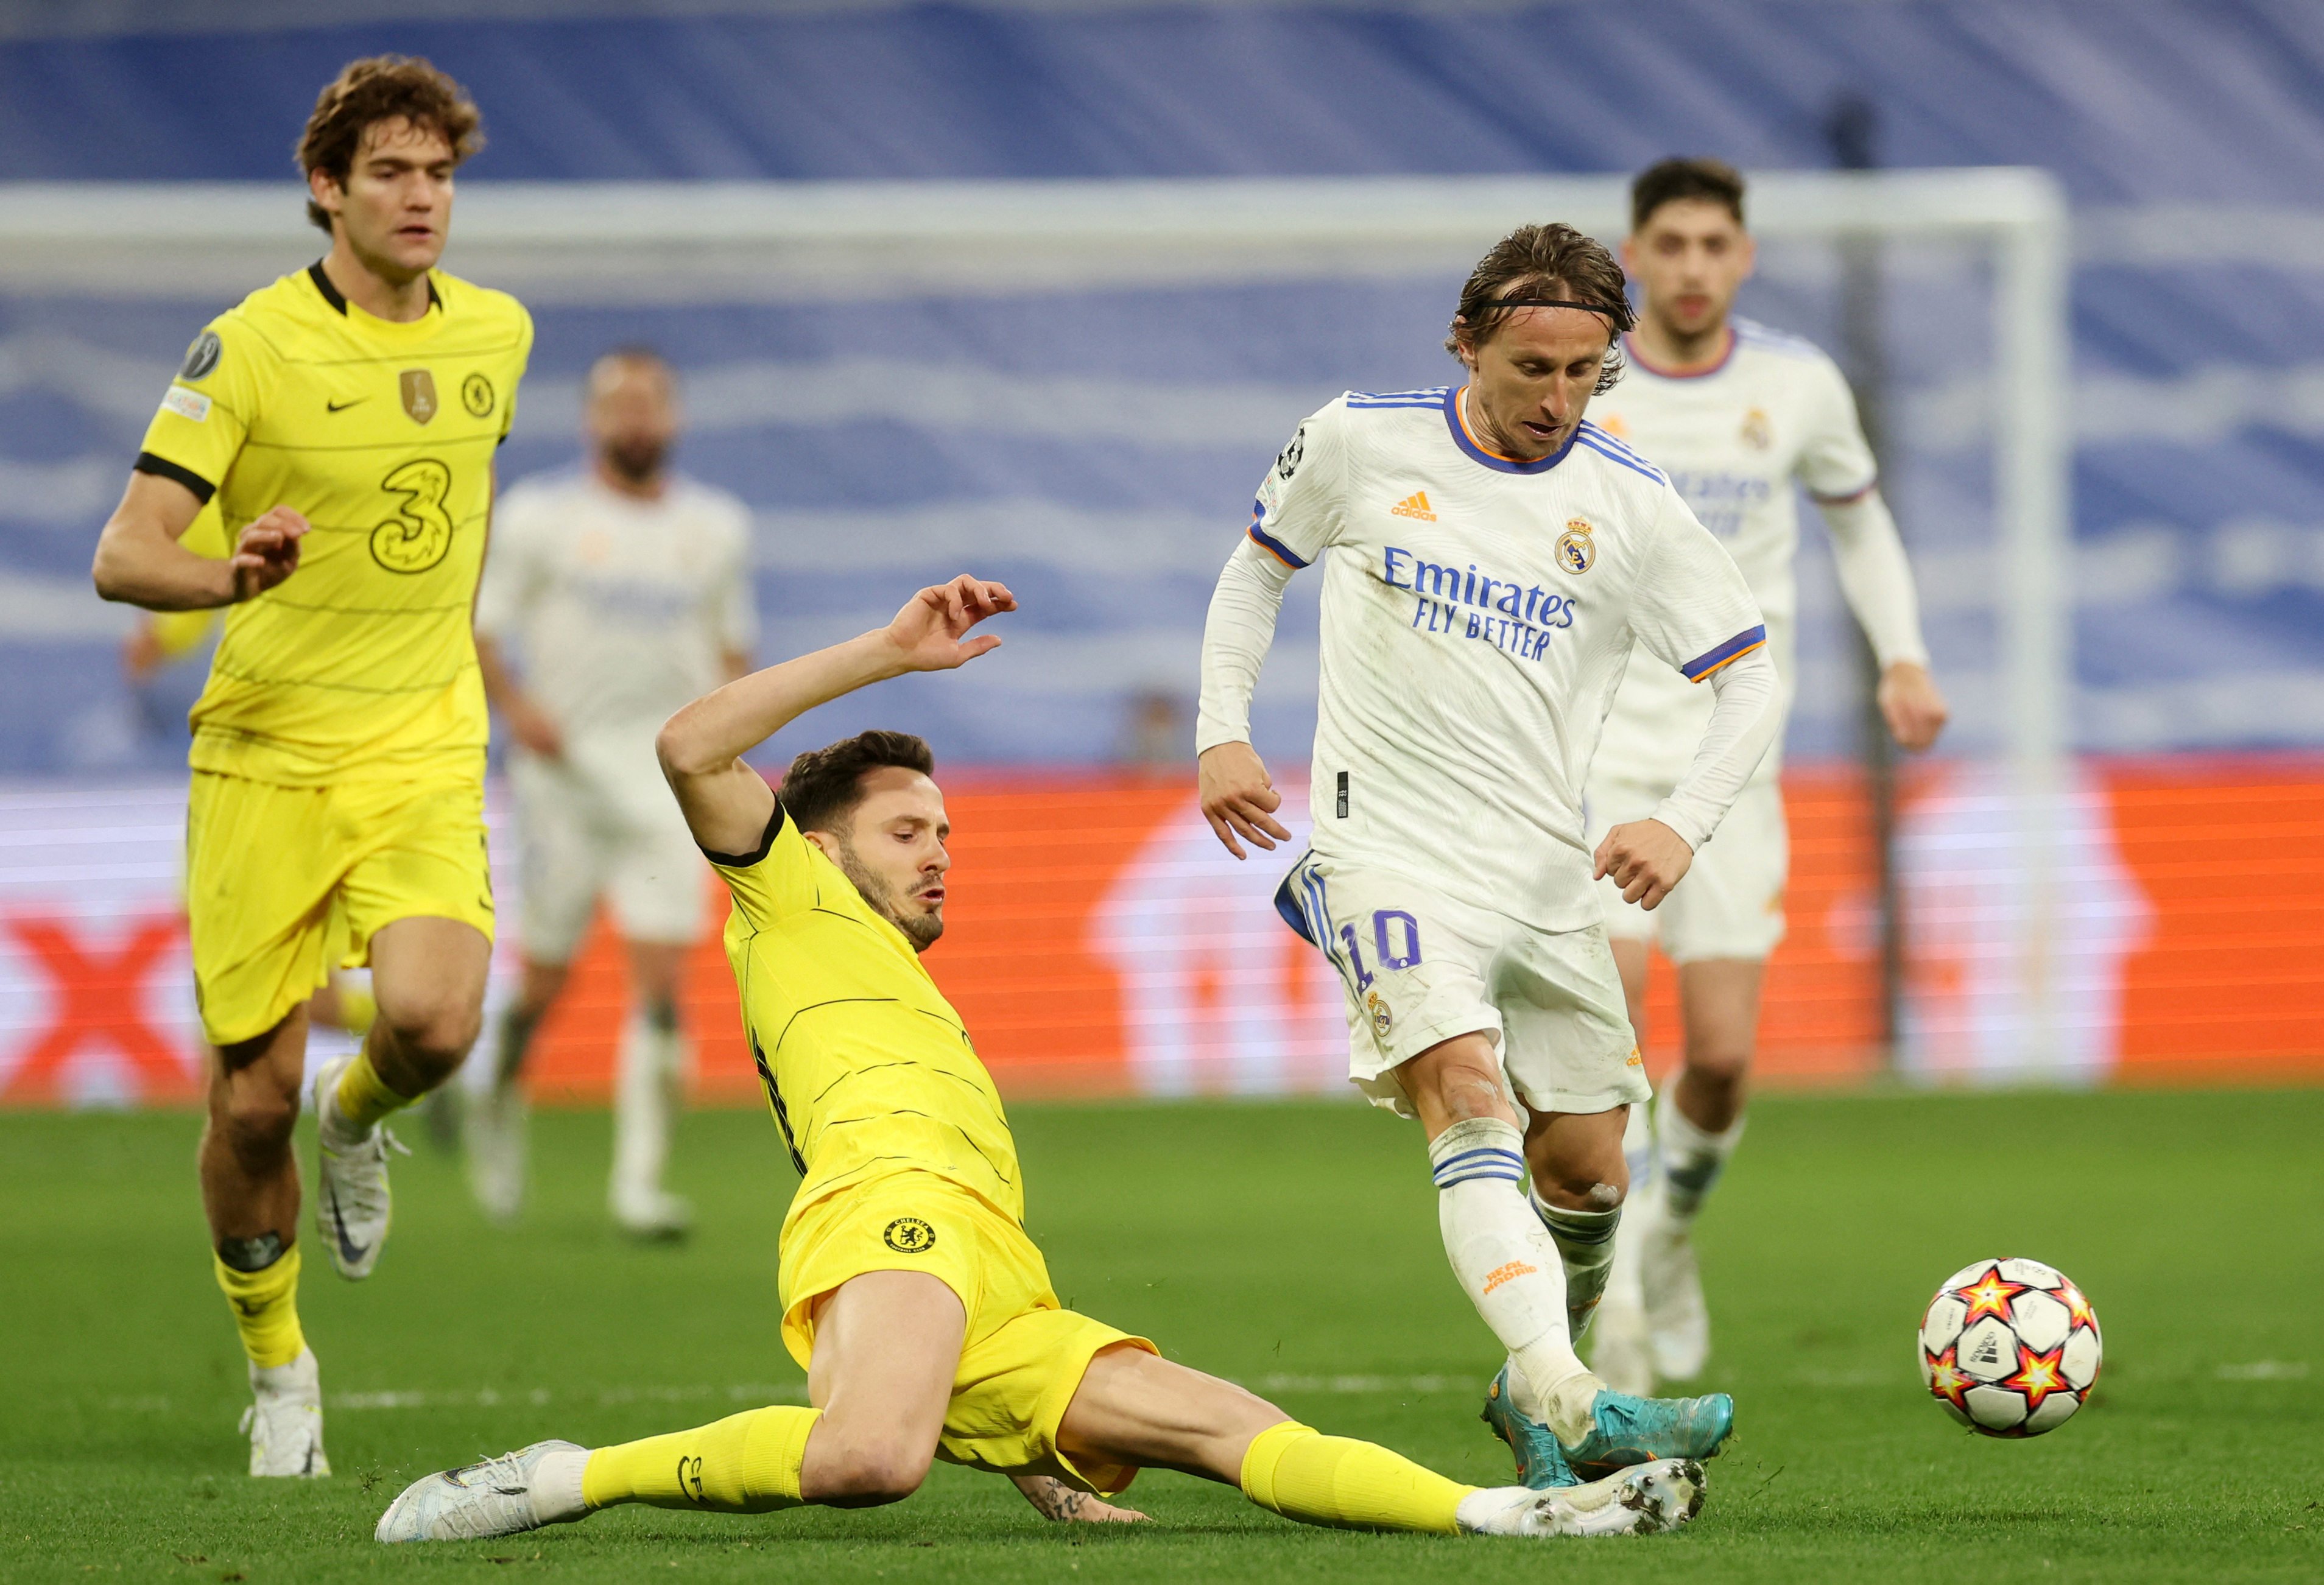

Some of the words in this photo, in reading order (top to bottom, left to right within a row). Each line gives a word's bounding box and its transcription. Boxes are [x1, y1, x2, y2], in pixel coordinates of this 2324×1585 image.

[370, 458, 453, 575] 3
[1391, 507, 1437, 522] adidas
[1384, 546, 1576, 628] Emirates
[1412, 598, 1457, 633] FLY
[1465, 612, 1550, 662] BETTER
[1340, 909, 1423, 999] 10
[895, 1218, 929, 1229] CHELSEA
[1483, 1266, 1537, 1295] MADRID
[1486, 1260, 1526, 1282] REAL
